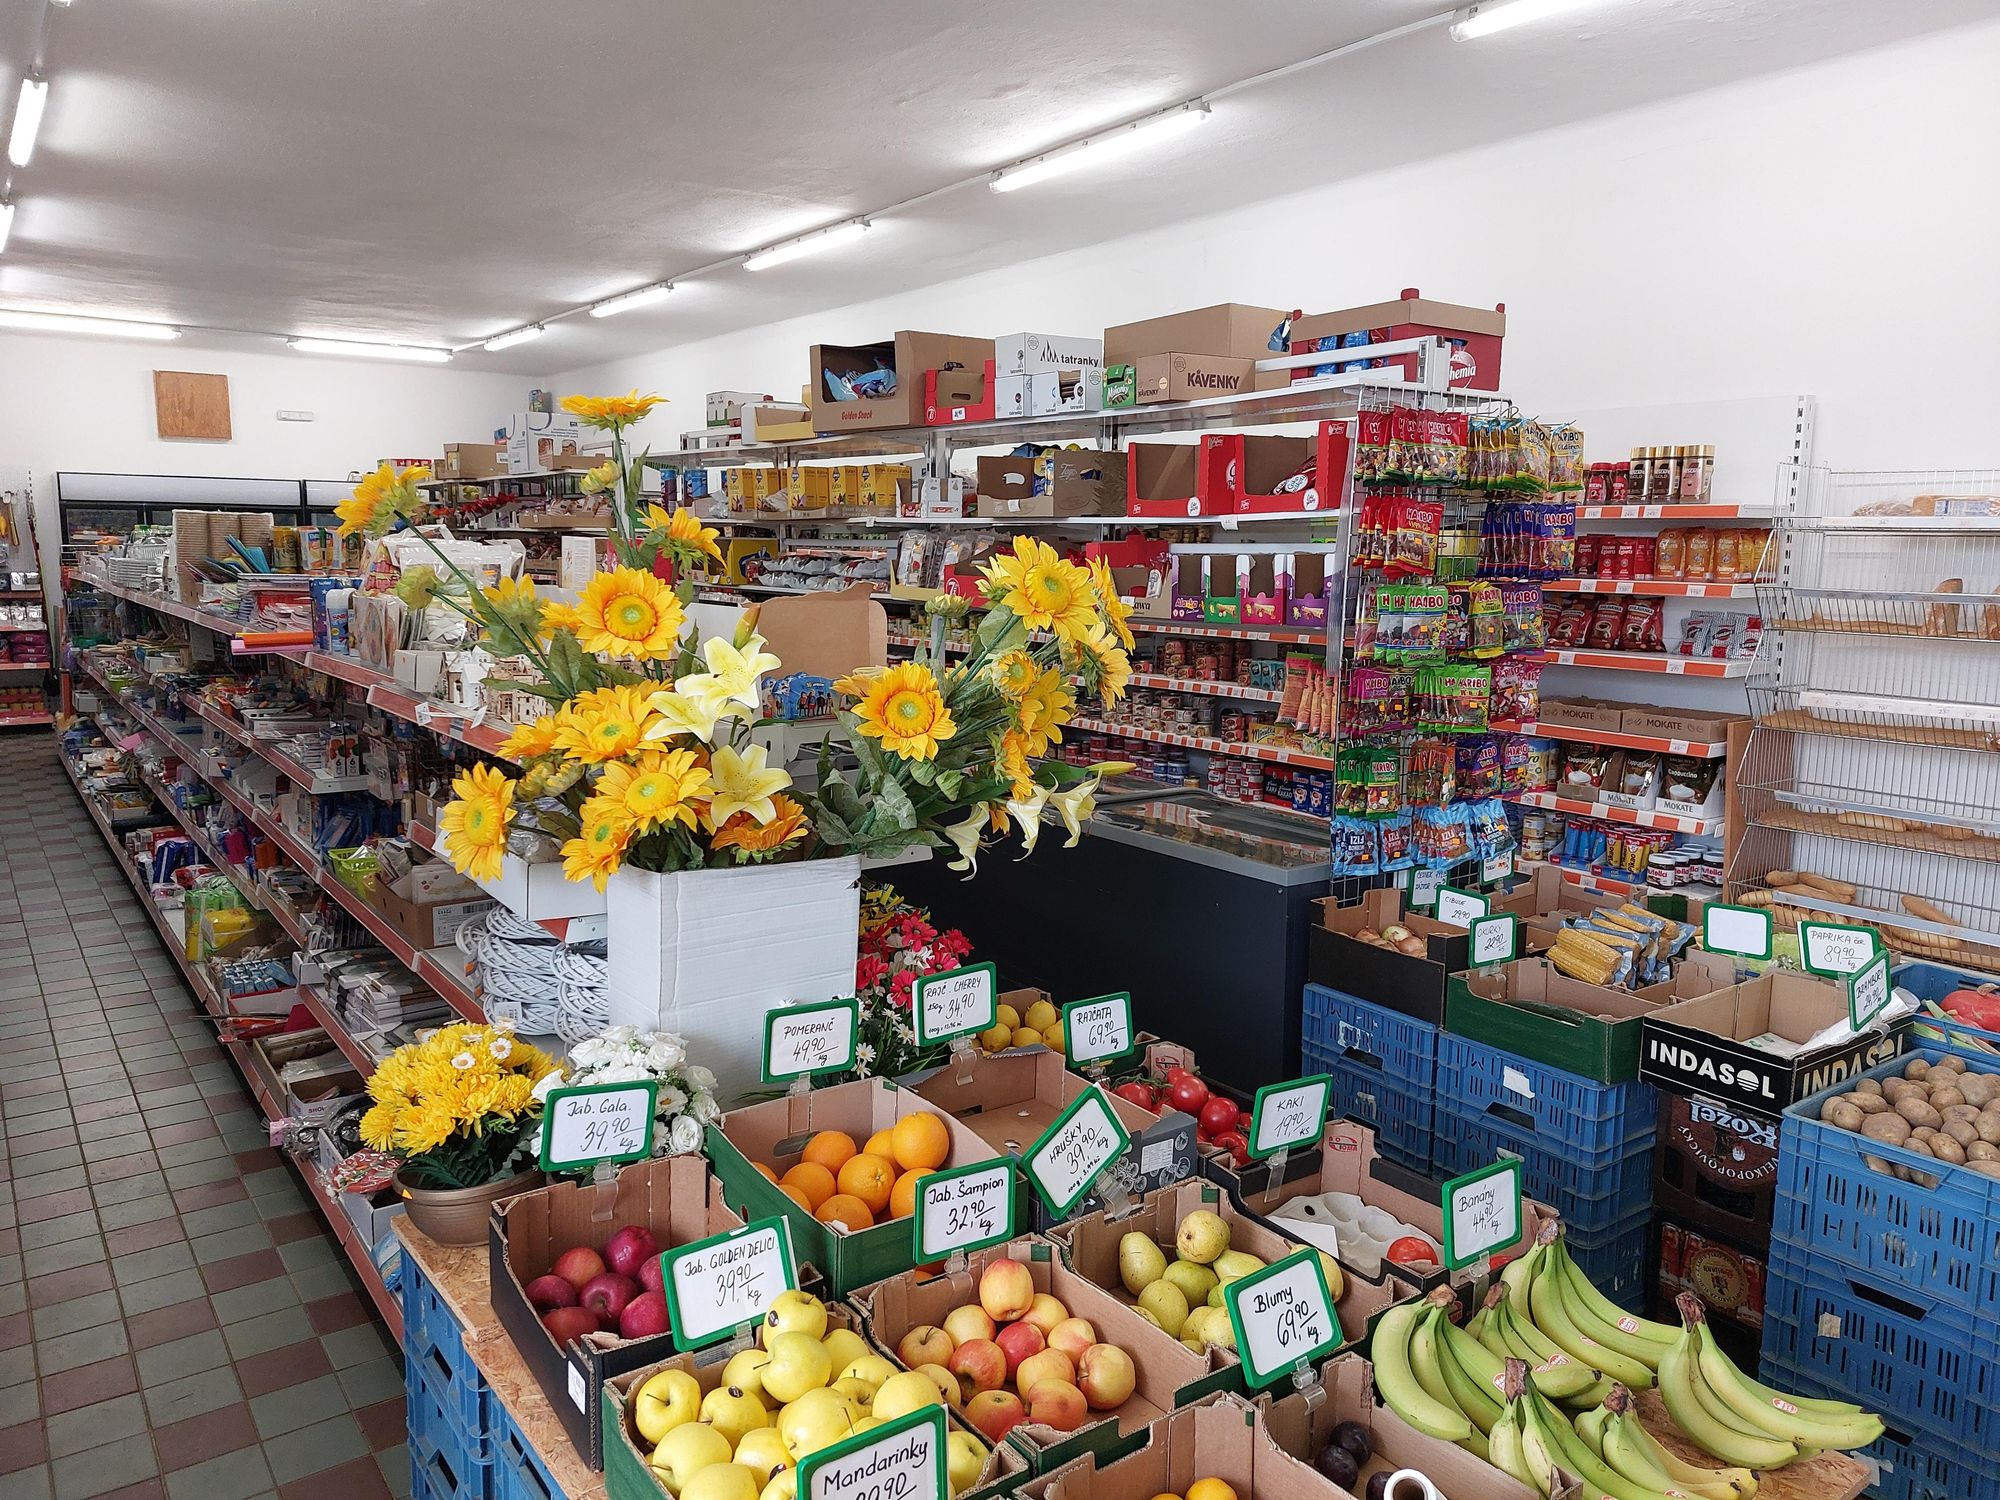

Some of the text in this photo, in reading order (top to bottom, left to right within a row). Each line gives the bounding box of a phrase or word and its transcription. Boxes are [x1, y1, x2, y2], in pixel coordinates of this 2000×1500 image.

[1061, 354, 1099, 368] tatranky
[1187, 369, 1240, 390] KÁVENKY
[1450, 365, 1476, 380] hemia
[1562, 710, 1594, 720] MOKATE
[1646, 719, 1682, 730] MOKATE
[1668, 768, 1698, 778] Cappuccino
[1278, 789, 1292, 799] KAKAO
[1664, 801, 1693, 812] MOKATE
[1810, 930, 1852, 944] PAPRIKA
[954, 976, 982, 992] CHERRY
[1076, 1006, 1113, 1024] RAJČATA
[784, 1017, 835, 1040] POMERANČ
[1650, 1040, 1776, 1100] INDASOL
[1277, 1096, 1304, 1112] KAKI
[1686, 1100, 1778, 1150] Kozel
[1049, 1122, 1082, 1164] HRUŠKY
[959, 1178, 1004, 1200] Šampion
[1459, 1184, 1496, 1212] Banány
[710, 1244, 746, 1270] GOLDEN
[1254, 1286, 1292, 1314] Blumy
[824, 1437, 928, 1496] Mandarinky
